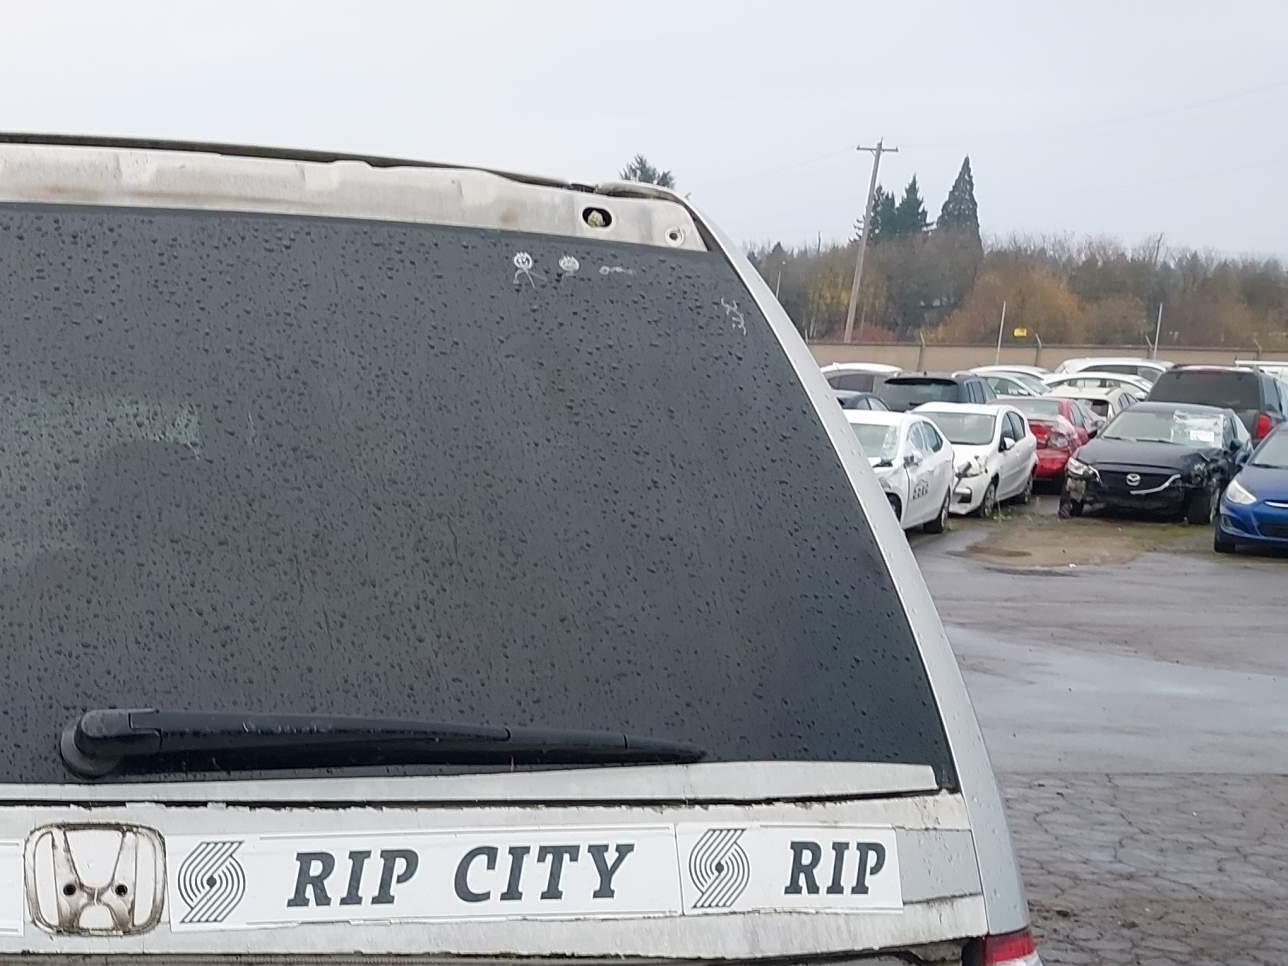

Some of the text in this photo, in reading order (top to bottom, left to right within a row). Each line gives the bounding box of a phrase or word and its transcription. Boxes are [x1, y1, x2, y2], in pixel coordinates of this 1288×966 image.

[286, 843, 635, 908] RIP CITY
[783, 841, 886, 895] RIP
